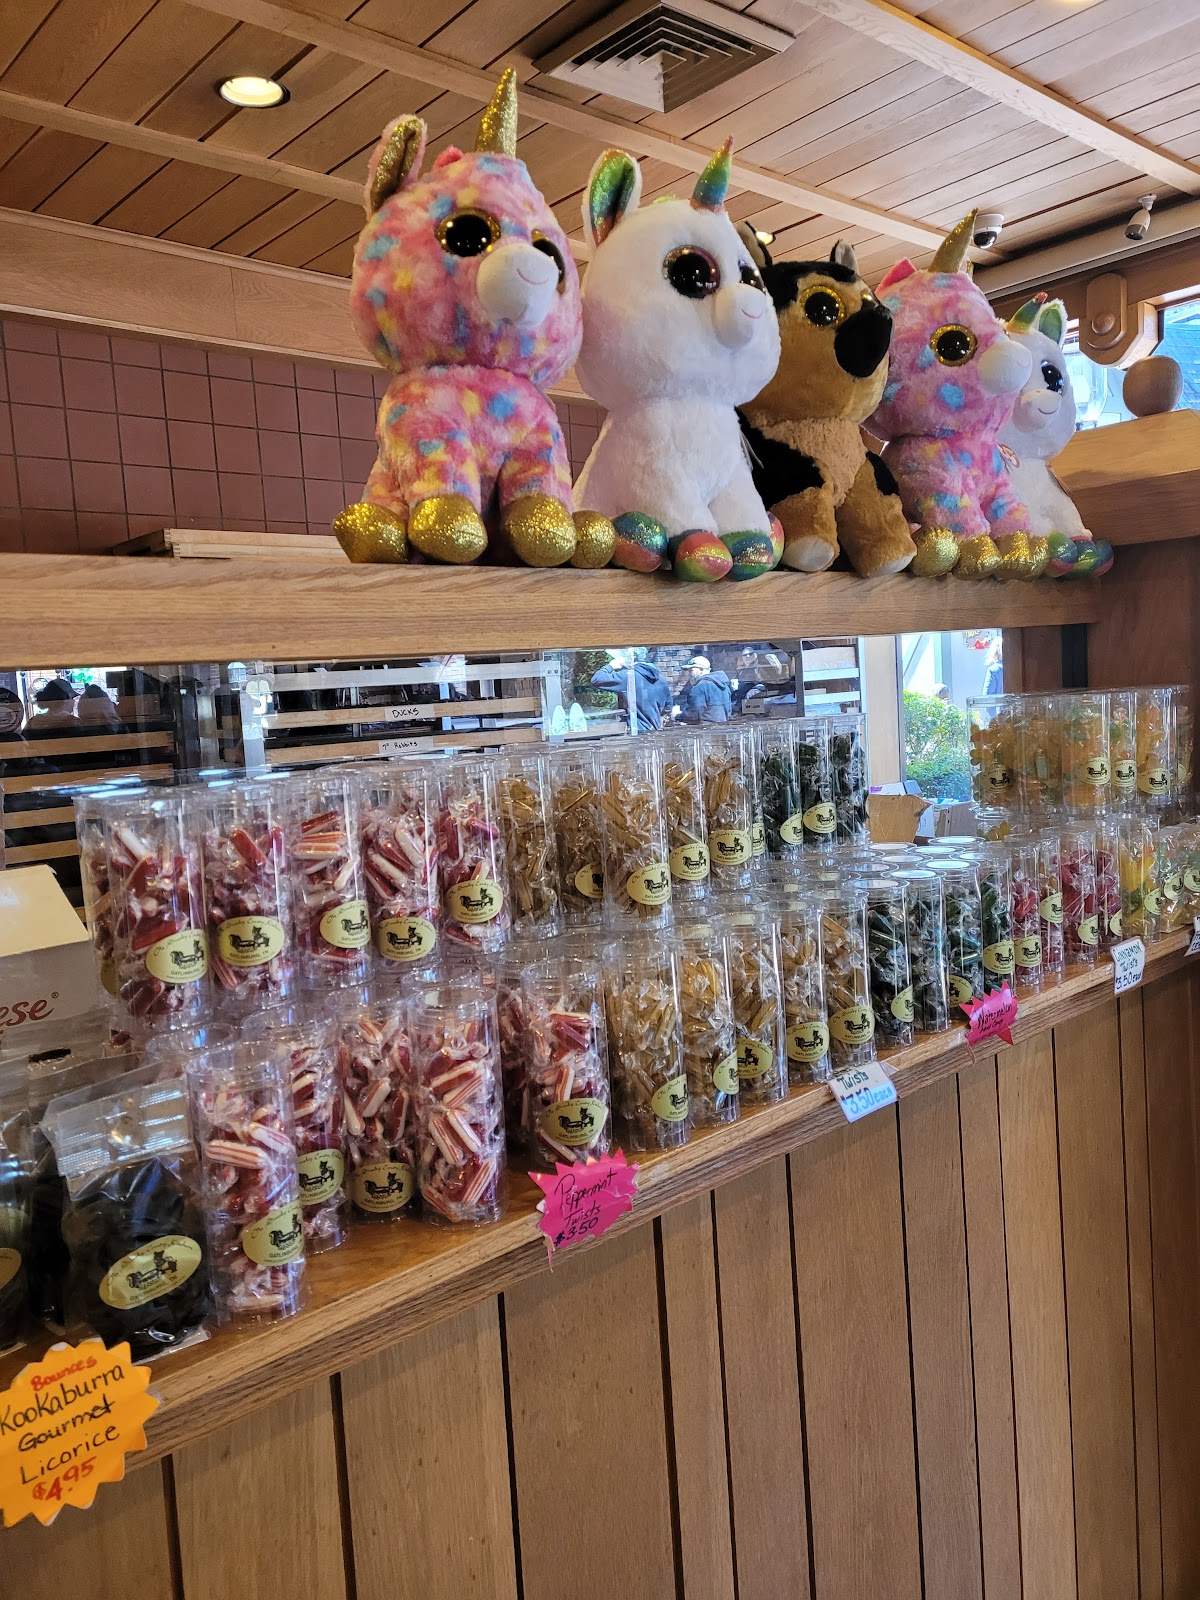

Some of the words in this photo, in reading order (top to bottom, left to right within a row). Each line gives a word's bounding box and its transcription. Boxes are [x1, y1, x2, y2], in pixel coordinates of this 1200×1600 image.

[391, 707, 419, 718] DUCKS
[564, 1201, 601, 1229] Twists
[18, 1393, 116, 1453] Gourmet
[20, 1425, 121, 1485] Licorice
[31, 1456, 98, 1501] $4.95
